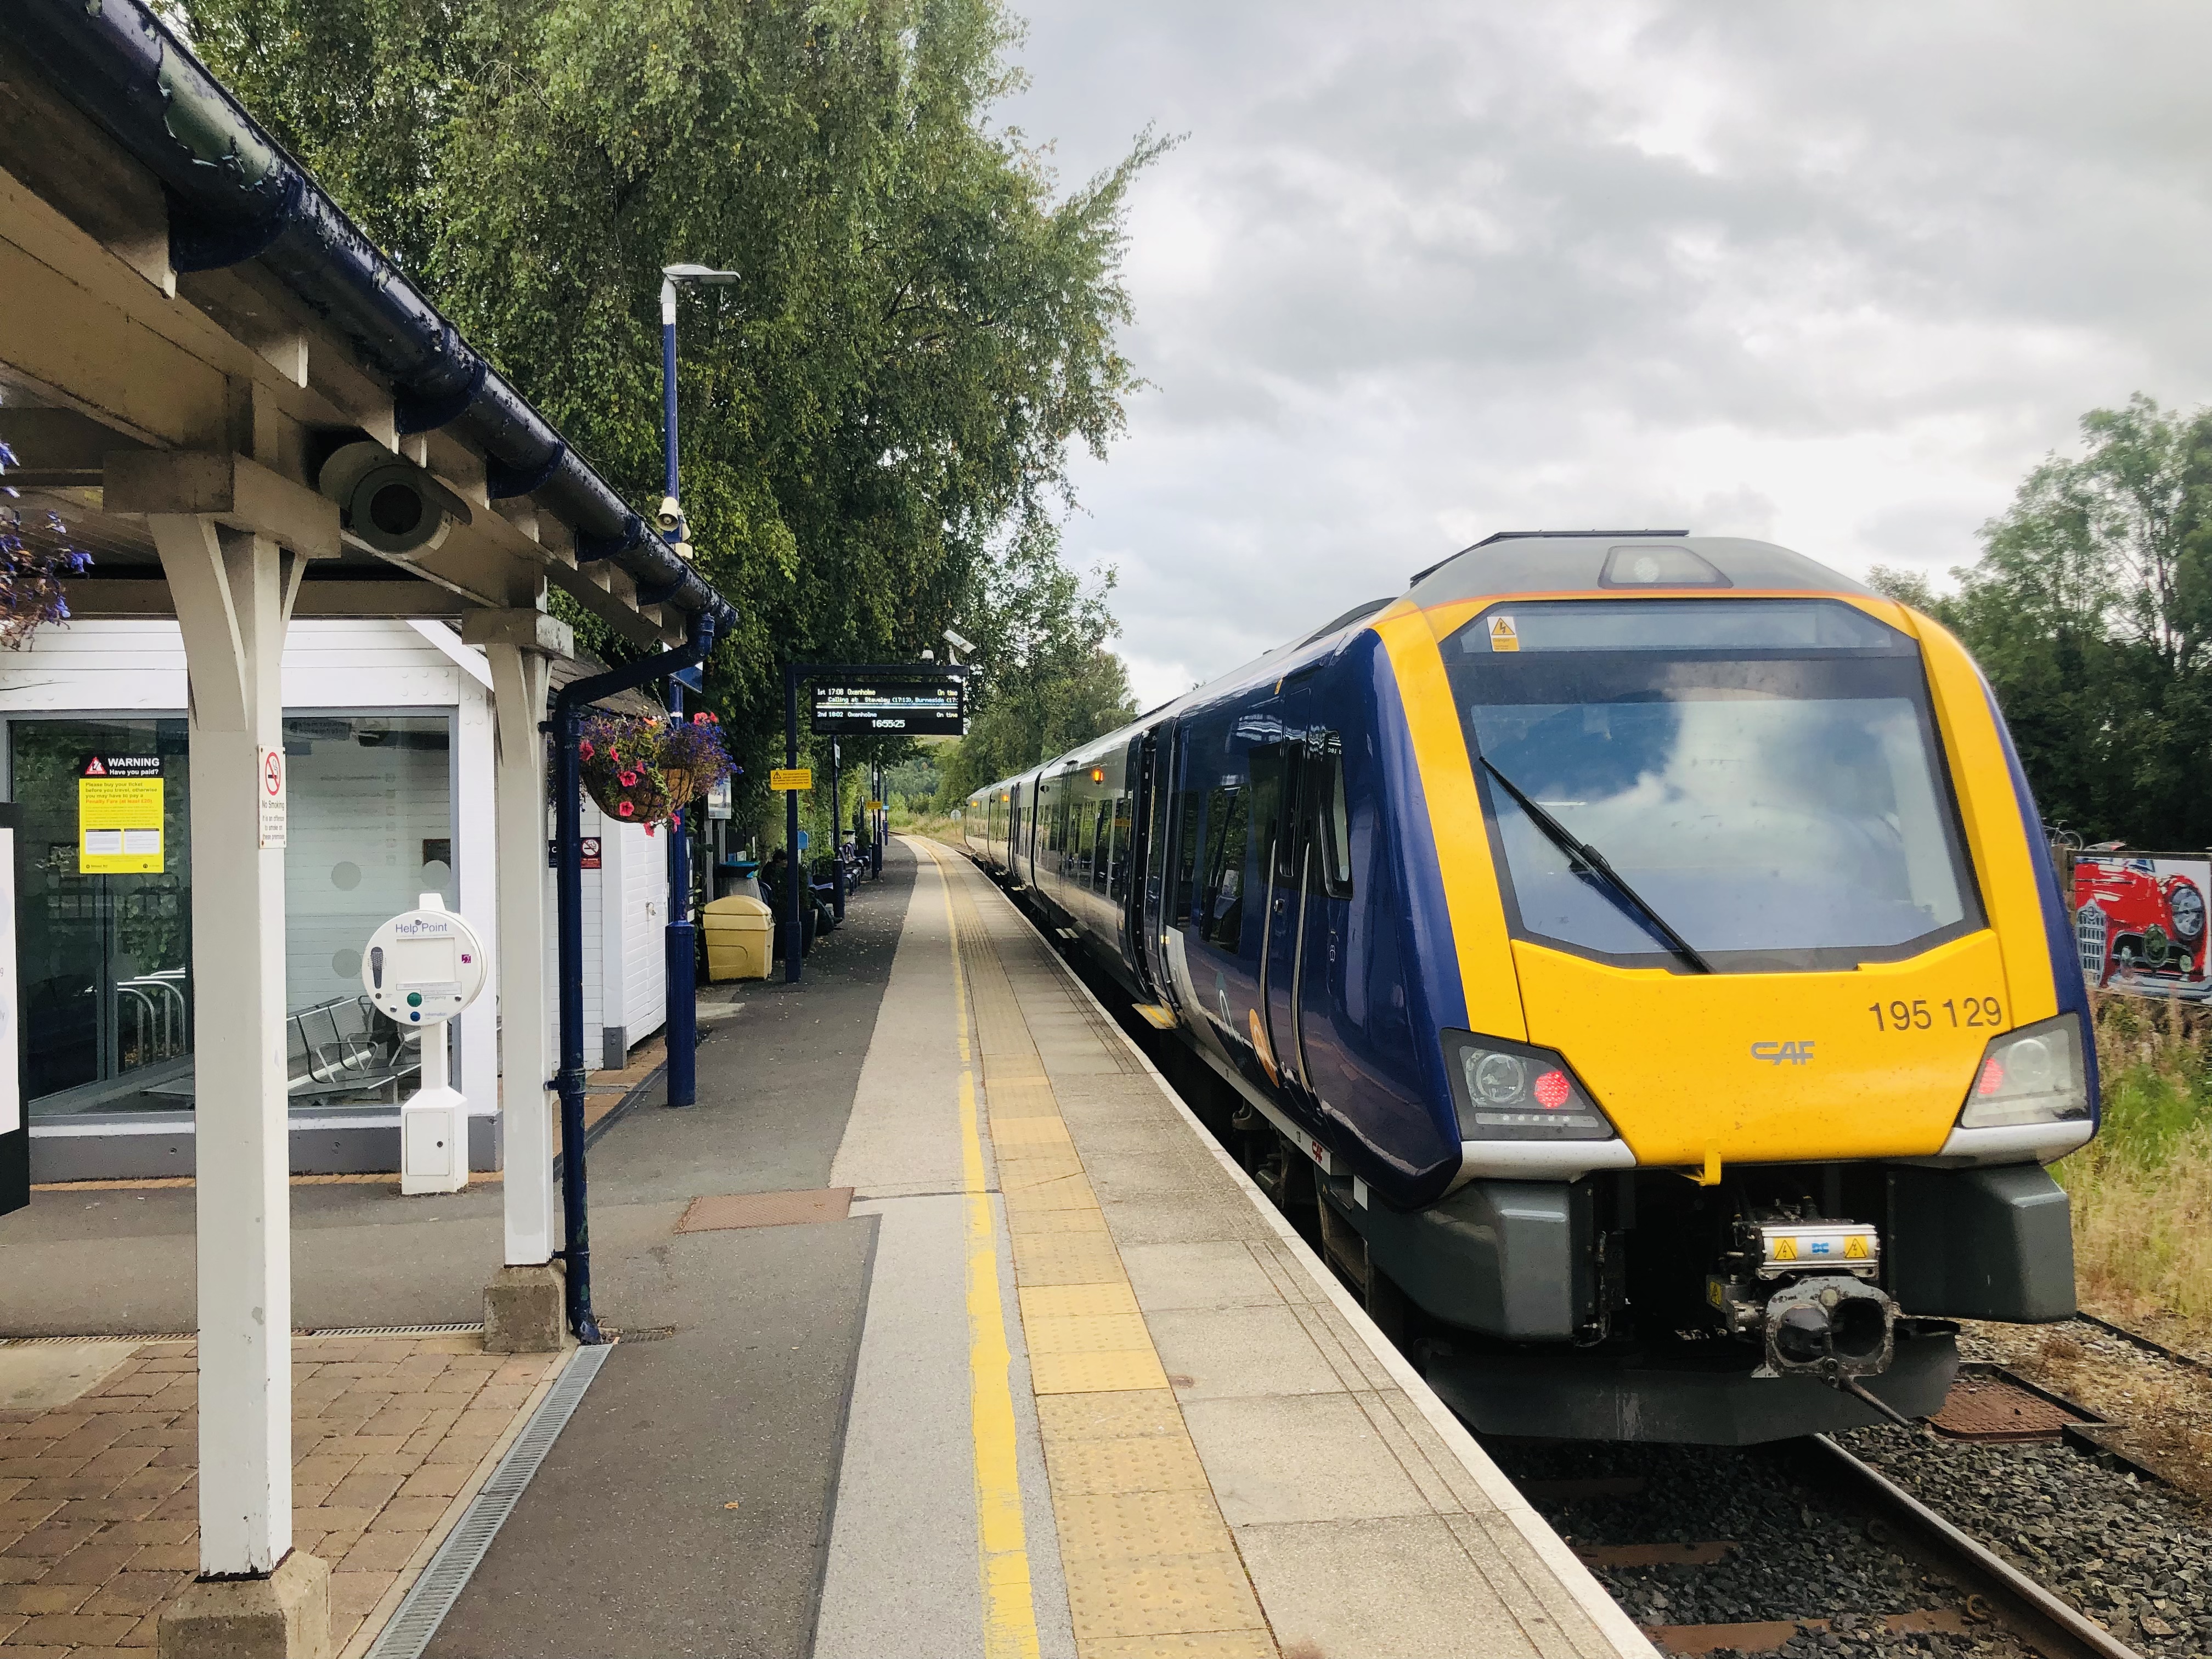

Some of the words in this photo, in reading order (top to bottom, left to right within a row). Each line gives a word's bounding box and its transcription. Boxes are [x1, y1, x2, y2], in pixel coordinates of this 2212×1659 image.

[108, 758, 160, 766] WARNING
[268, 800, 285, 811] Smoking
[396, 924, 418, 934] Help
[422, 923, 447, 932] Point
[1869, 1000, 1932, 1031] 195
[1942, 996, 2002, 1028] 129
[1750, 1041, 1815, 1065] CAF
